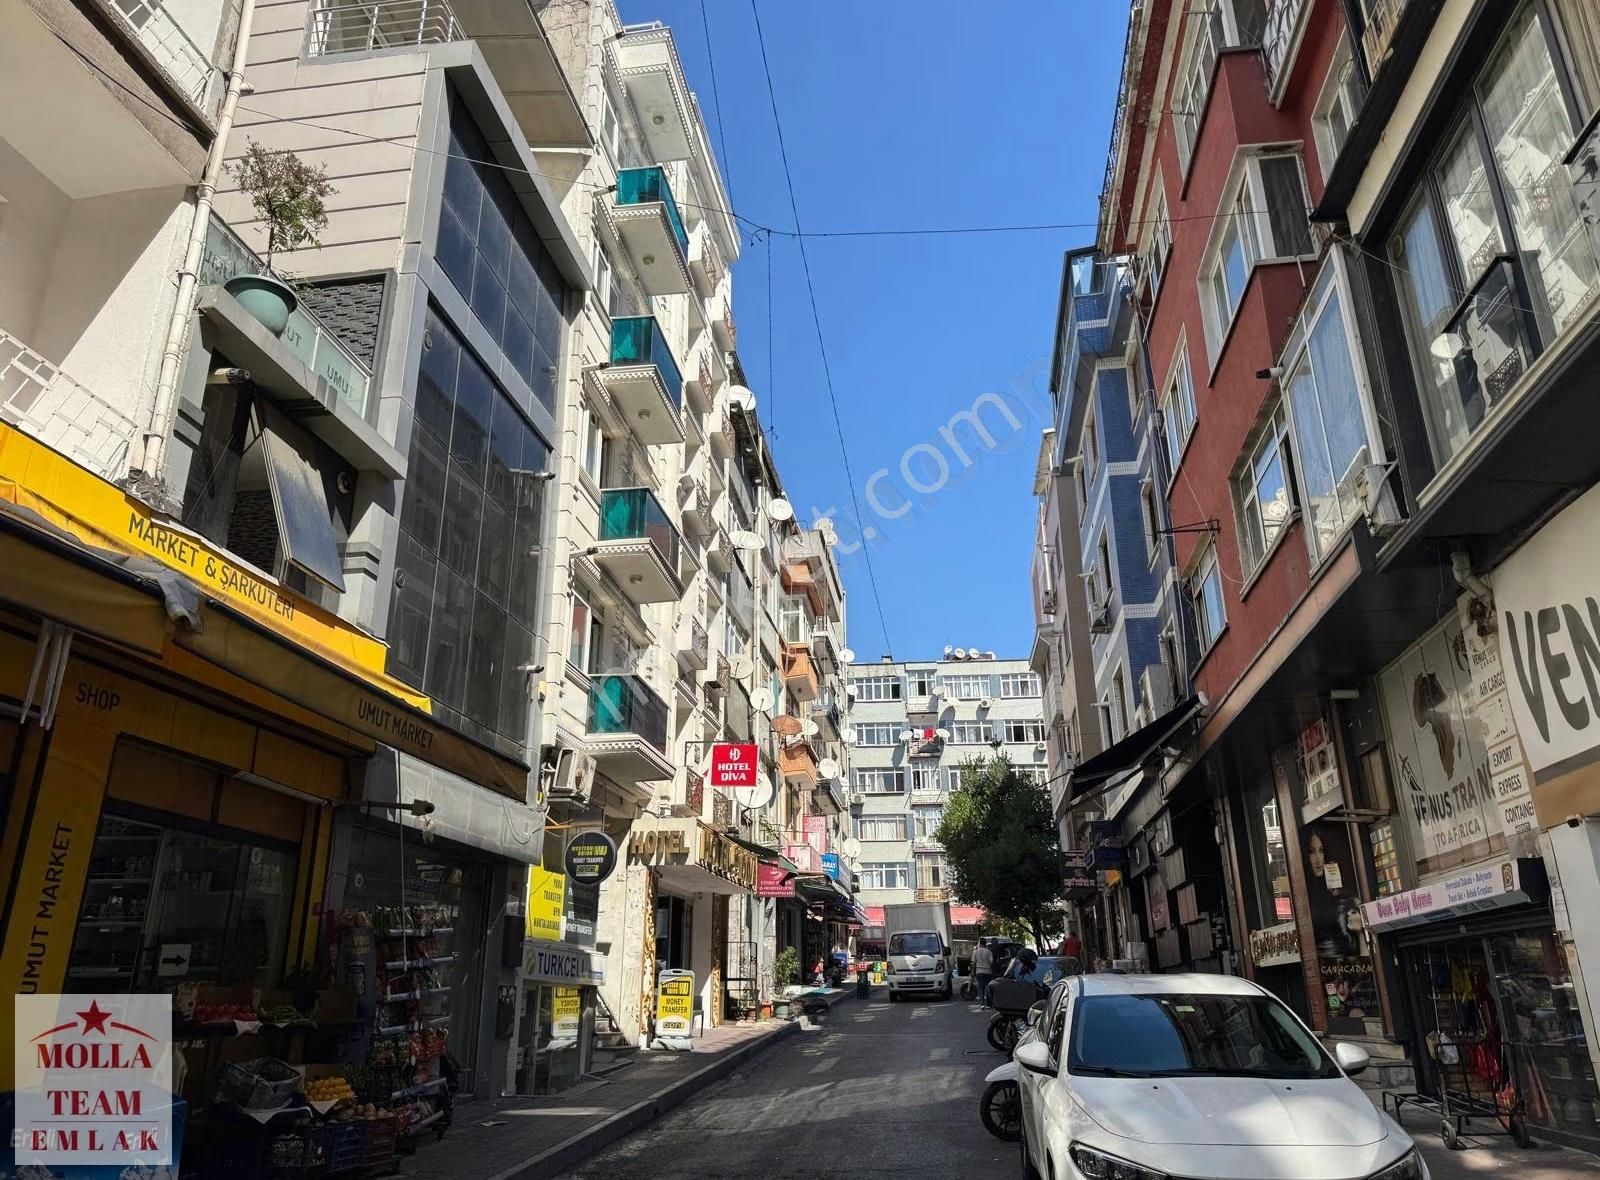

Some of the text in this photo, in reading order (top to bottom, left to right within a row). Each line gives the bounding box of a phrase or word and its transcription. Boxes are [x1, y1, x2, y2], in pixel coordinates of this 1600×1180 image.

[128, 512, 199, 567] MARKET
[205, 556, 216, 579] &
[76, 682, 120, 713] SHOP
[1480, 684, 1489, 697] AIR
[357, 698, 436, 749] UMUT MARKET
[717, 762, 751, 771] HOTEL
[1493, 746, 1513, 767] EXPORT
[721, 770, 747, 781] DİVA
[1499, 774, 1521, 796] EXPRESS
[630, 830, 690, 854] HOTEL
[1435, 818, 1481, 847] TO AFRICA
[21, 821, 73, 994] UMUT MARKET
[538, 952, 586, 978] TURKCELL
[662, 1006, 688, 1014] TRANSFER
[666, 998, 684, 1006] MONEY
